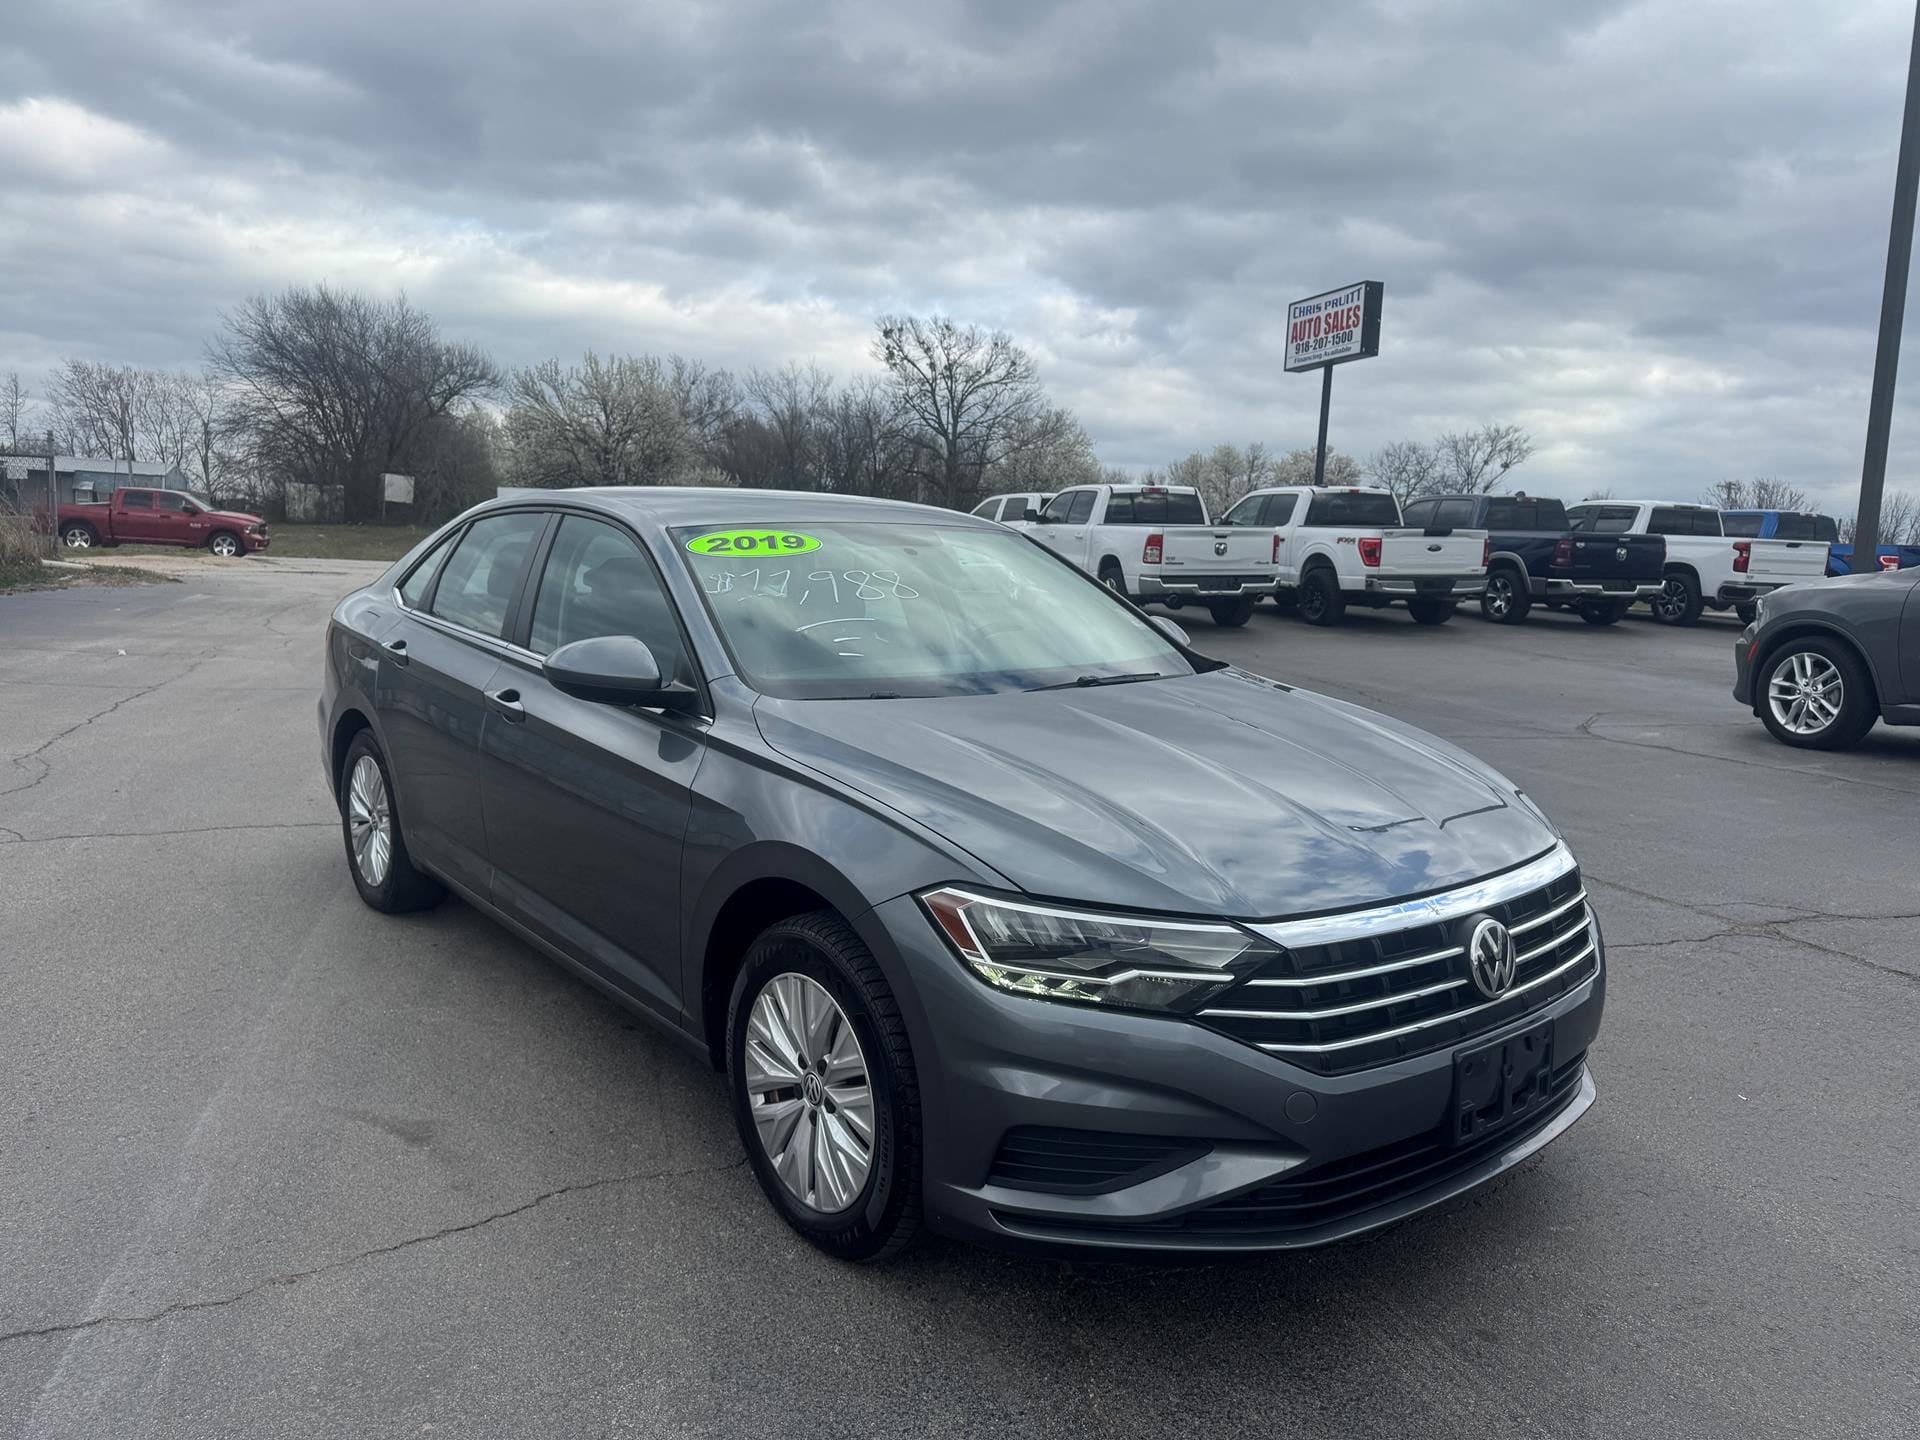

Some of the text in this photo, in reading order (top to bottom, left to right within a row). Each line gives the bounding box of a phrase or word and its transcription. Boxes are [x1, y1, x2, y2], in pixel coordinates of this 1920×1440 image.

[1293, 287, 1363, 319] CHRIS PRUITT
[1291, 304, 1360, 344] AUTO SALES
[1295, 330, 1353, 355] 918-207-1500
[707, 535, 805, 552] 2019
